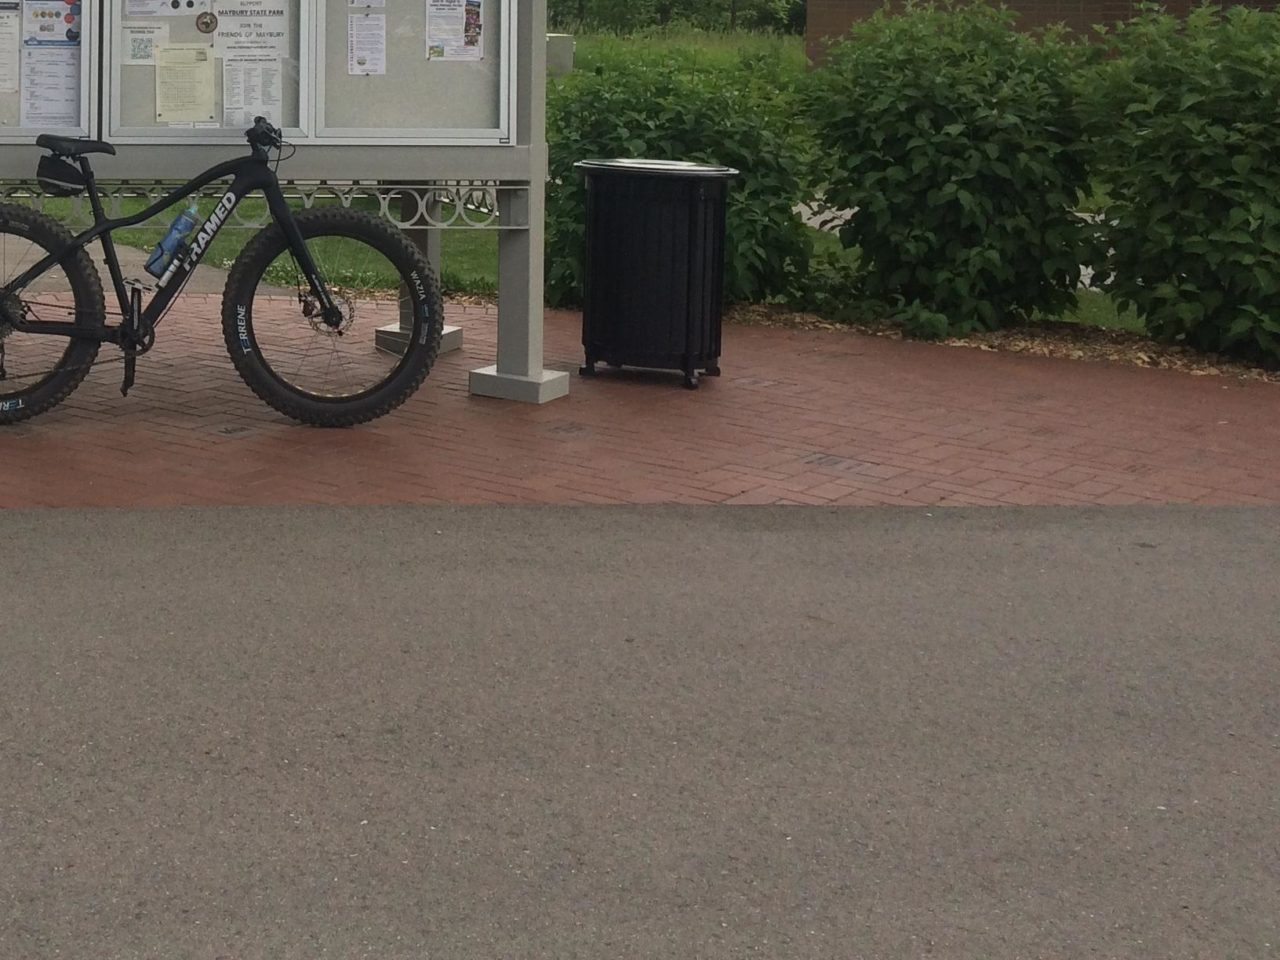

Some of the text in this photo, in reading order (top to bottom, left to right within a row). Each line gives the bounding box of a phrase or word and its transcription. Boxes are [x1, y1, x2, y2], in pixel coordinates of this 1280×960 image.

[183, 191, 236, 272] FRAMED
[410, 270, 427, 301] WAZIA
[237, 304, 252, 355] TERRENE
